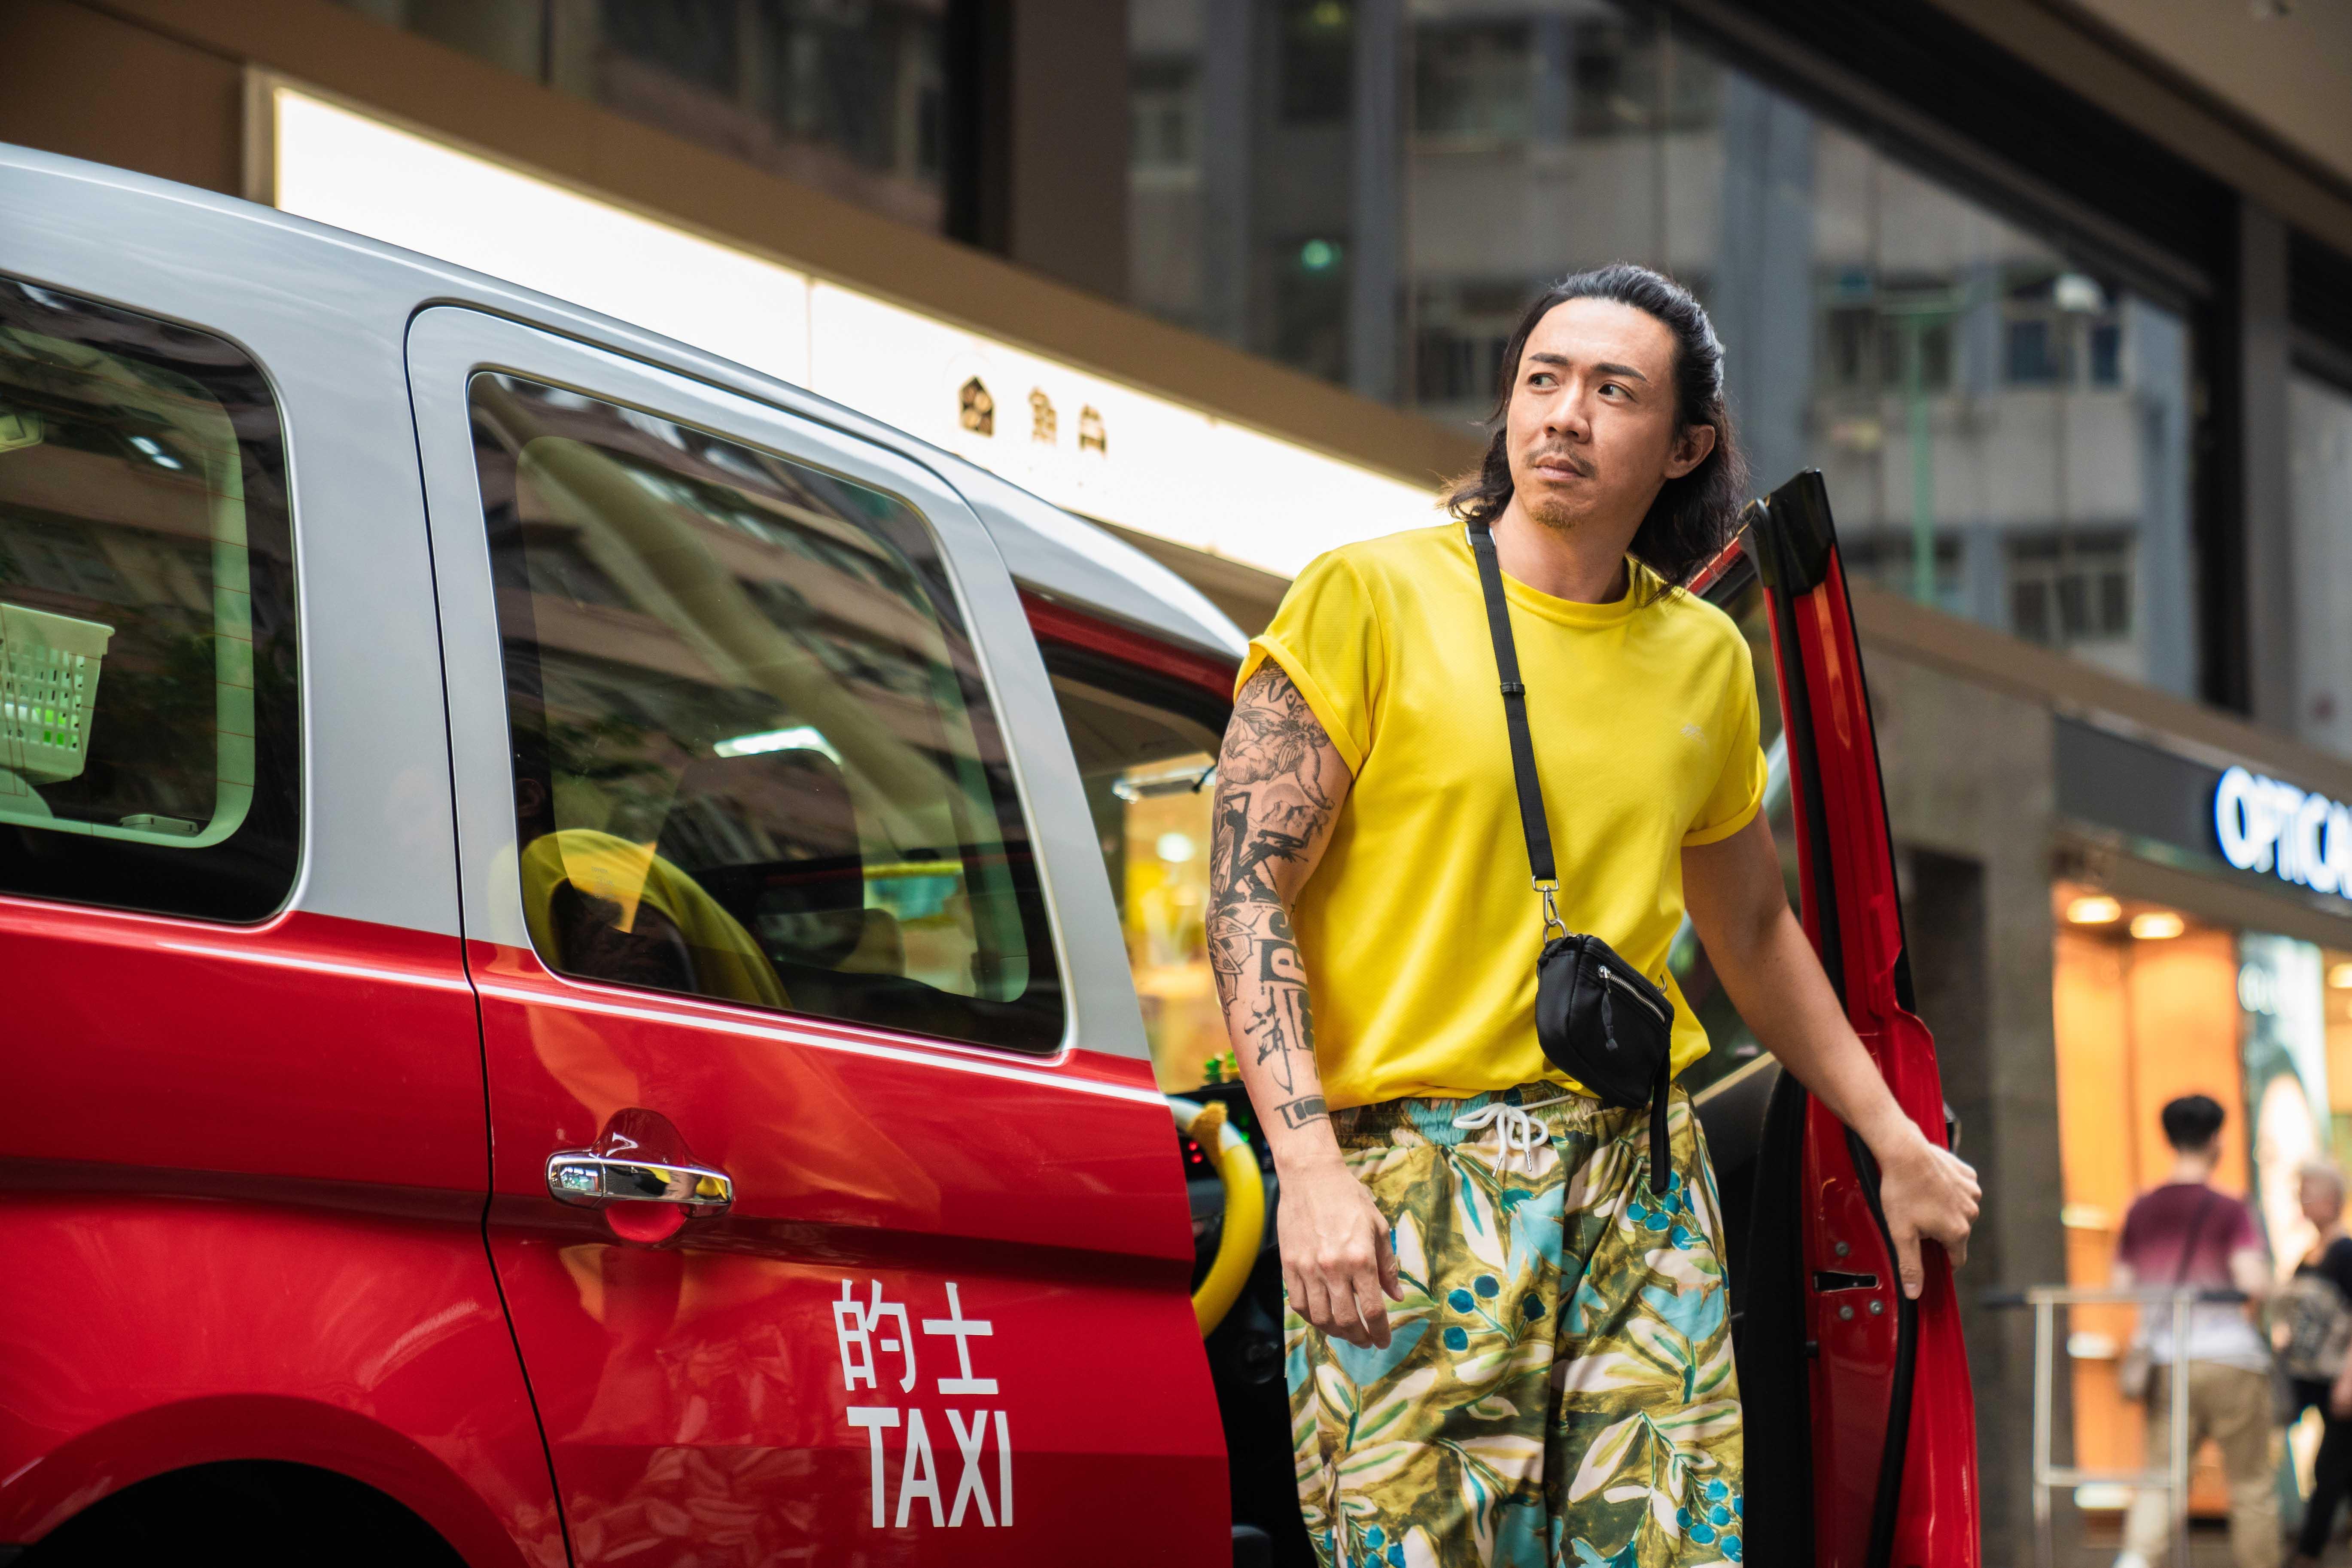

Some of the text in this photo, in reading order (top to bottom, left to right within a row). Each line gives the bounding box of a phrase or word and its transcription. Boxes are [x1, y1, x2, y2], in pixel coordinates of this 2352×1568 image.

[2214, 766, 2352, 899] OPTICA
[832, 1279, 998, 1394] 的士
[846, 1407, 1013, 1528] TAXI
